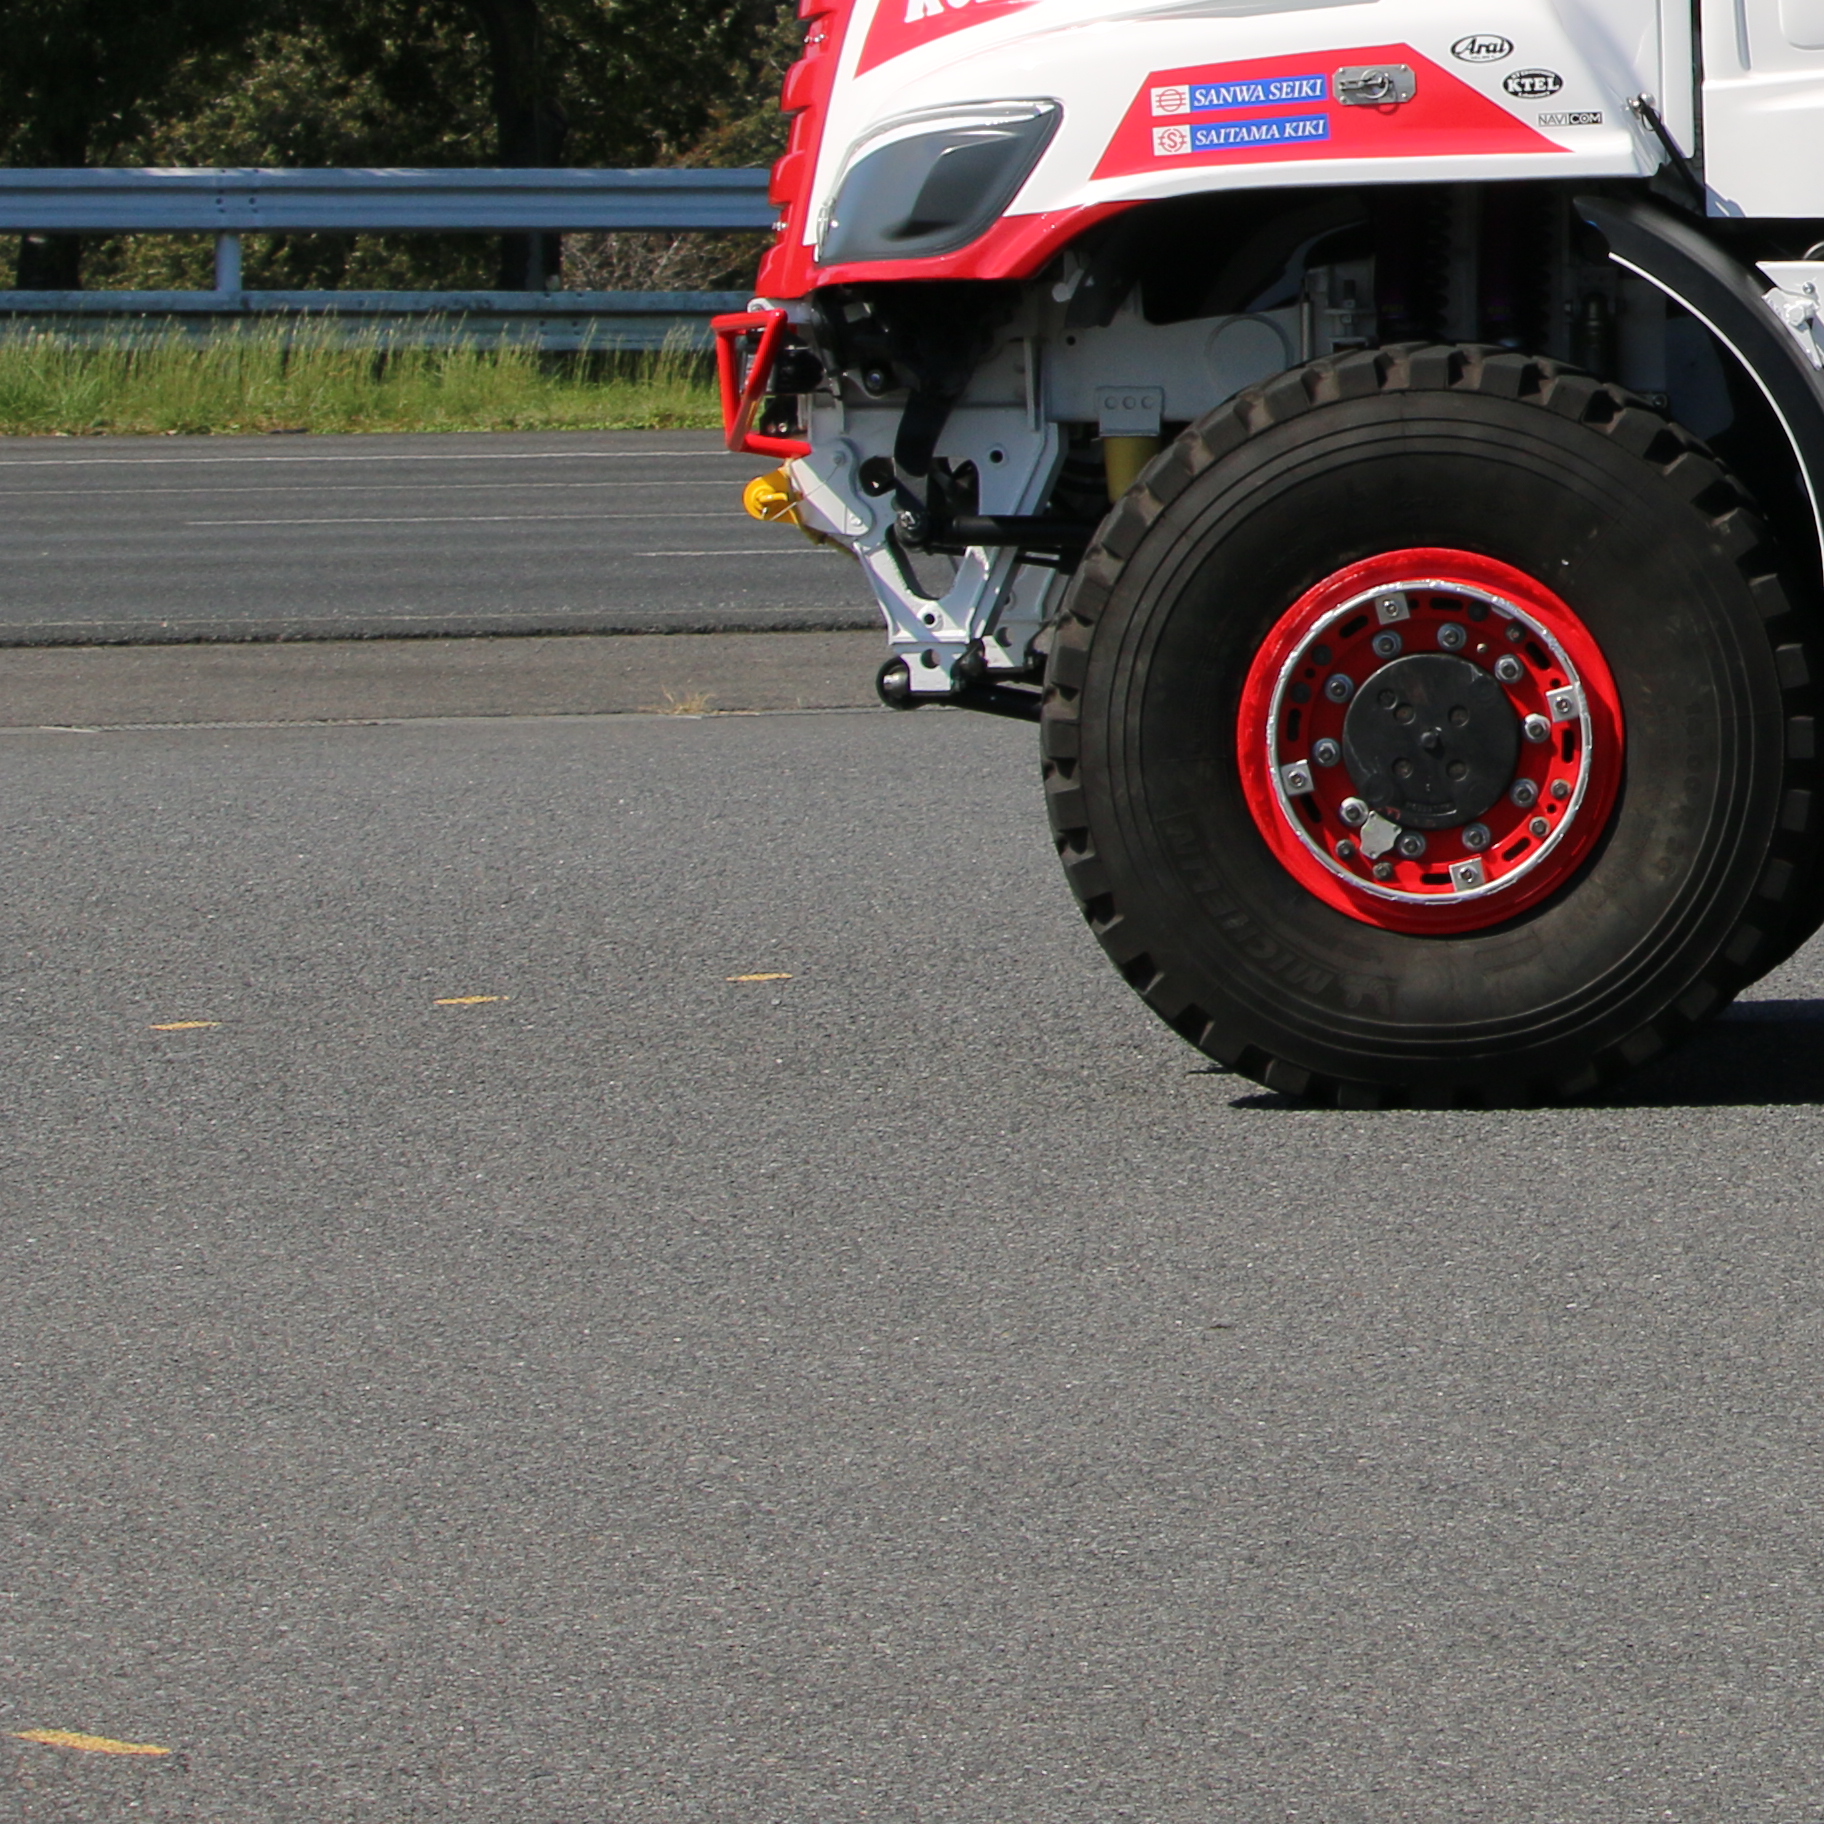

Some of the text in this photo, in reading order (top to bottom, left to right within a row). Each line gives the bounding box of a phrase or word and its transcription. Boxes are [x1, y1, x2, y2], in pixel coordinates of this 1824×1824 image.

[1456, 37, 1506, 55] Arai
[1193, 78, 1323, 108] SANWA SEIKI
[1507, 77, 1560, 93] KTEL
[1539, 112, 1602, 124] NAVICOM
[1195, 117, 1326, 146] SAITAMA KIKI
